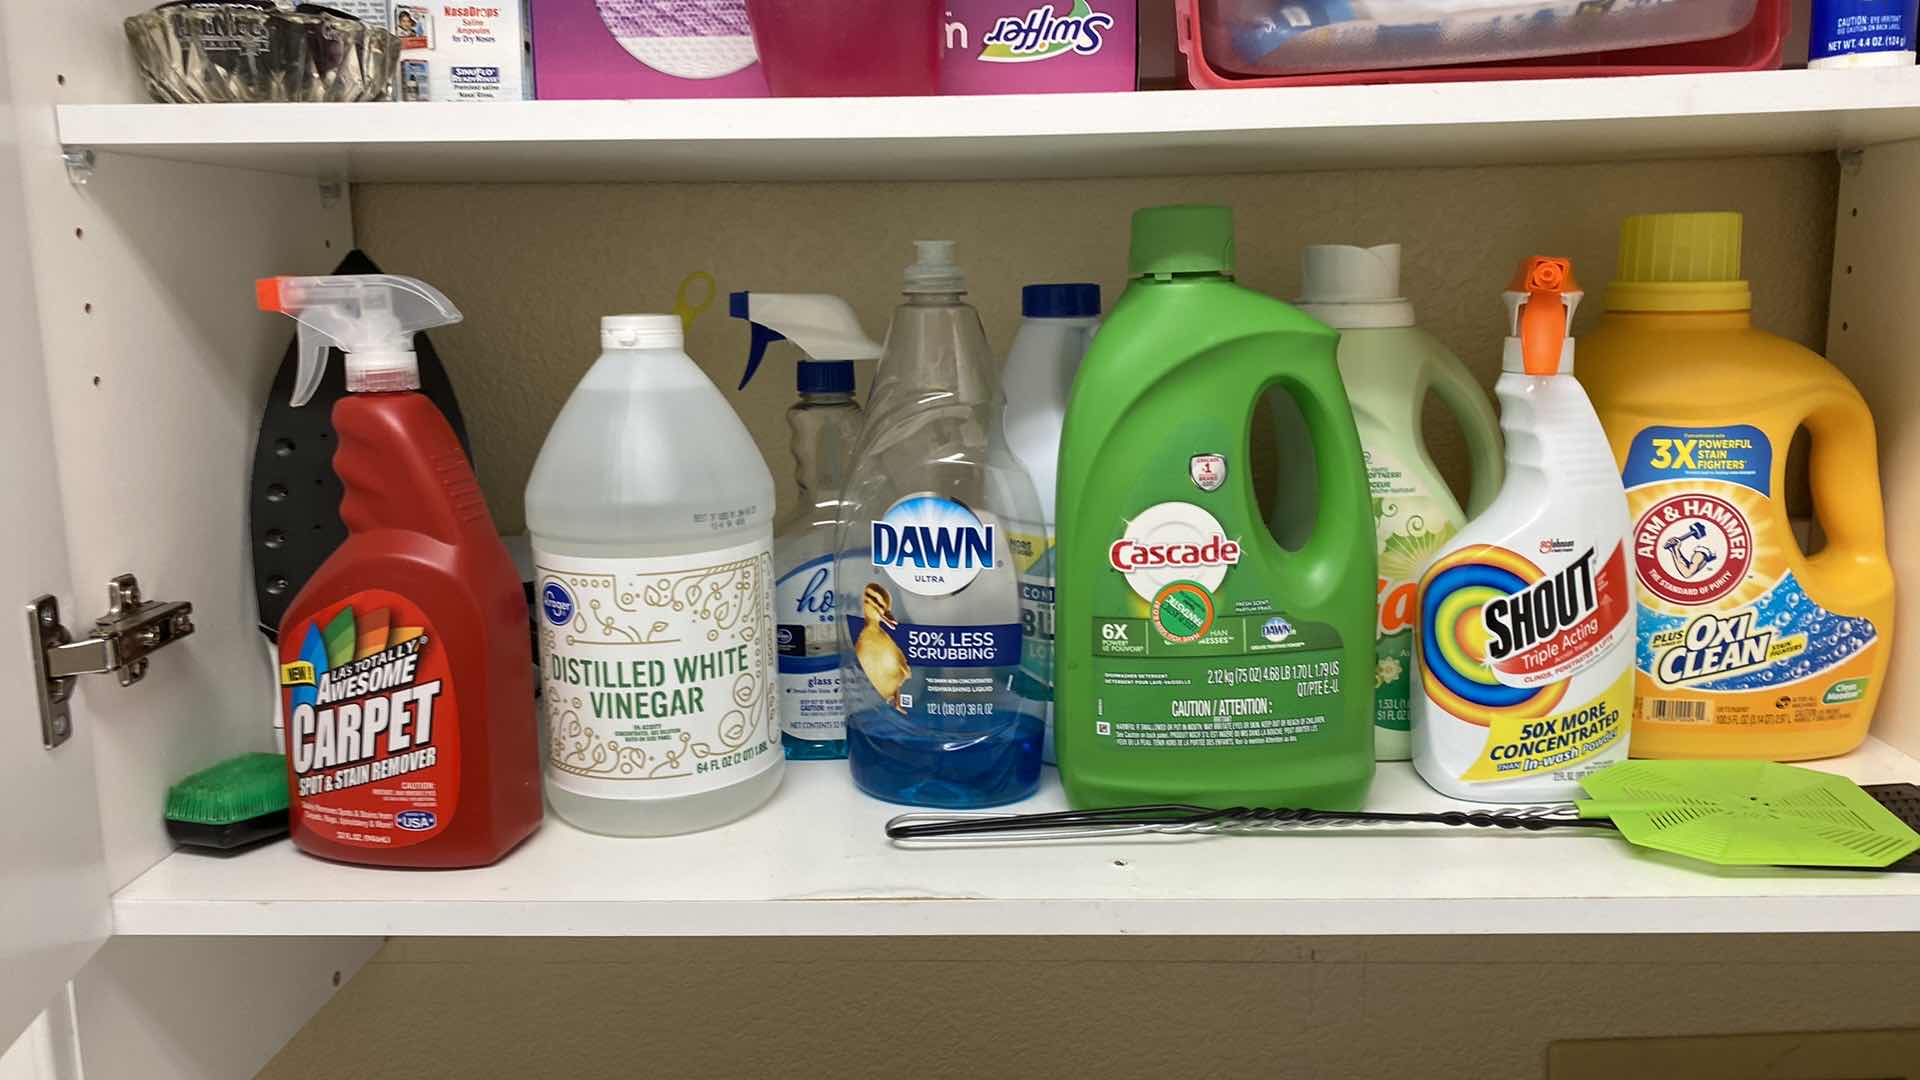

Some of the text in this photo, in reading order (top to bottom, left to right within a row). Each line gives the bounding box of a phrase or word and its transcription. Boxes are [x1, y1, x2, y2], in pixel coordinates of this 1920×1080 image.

[985, 6, 1112, 53] Swiffer
[1837, 16, 1869, 28] CAUTION:
[1828, 40, 1841, 51] NET
[1650, 439, 1698, 470] 3X
[1697, 450, 1728, 459] STAIN
[1698, 440, 1753, 449] POWERFUL
[872, 521, 995, 570] DAWN
[1637, 500, 1746, 560] ARM & HAMMER
[1110, 533, 1240, 572] Cascade
[914, 575, 945, 583] ULTRA
[1486, 546, 1594, 659] SHOUT
[908, 630, 994, 647] 50% LESS
[1102, 623, 1129, 641] 6X
[1521, 642, 1559, 670] Triple
[1562, 617, 1598, 651] Acting
[1653, 630, 1684, 644] PLUS
[1685, 613, 1753, 651] OXI
[354, 638, 418, 672] TOTALLY
[551, 644, 749, 688] DISTILLED WHITE
[1658, 631, 1772, 685] CLEAN
[316, 653, 418, 706] AWESOME
[807, 676, 833, 688] glass
[1207, 669, 1223, 684] 2.12
[1280, 665, 1291, 680] LB
[1292, 664, 1307, 679] 1.70
[590, 687, 704, 719] VINEGAR
[1171, 699, 1212, 717] CAUTION
[1218, 697, 1268, 717] ATTENTION
[292, 680, 441, 774] CARPET
[1489, 709, 1620, 761] CONCENTRATED
[1520, 719, 1557, 741] 50X
[1561, 701, 1606, 732] MORE
[298, 746, 437, 797] SPOT & STAIN REMOVER
[696, 762, 709, 774] 64
[710, 758, 720, 770] FL
[721, 755, 733, 767] OZ
[1521, 744, 1580, 772] In-wash
[402, 817, 430, 829] USA
